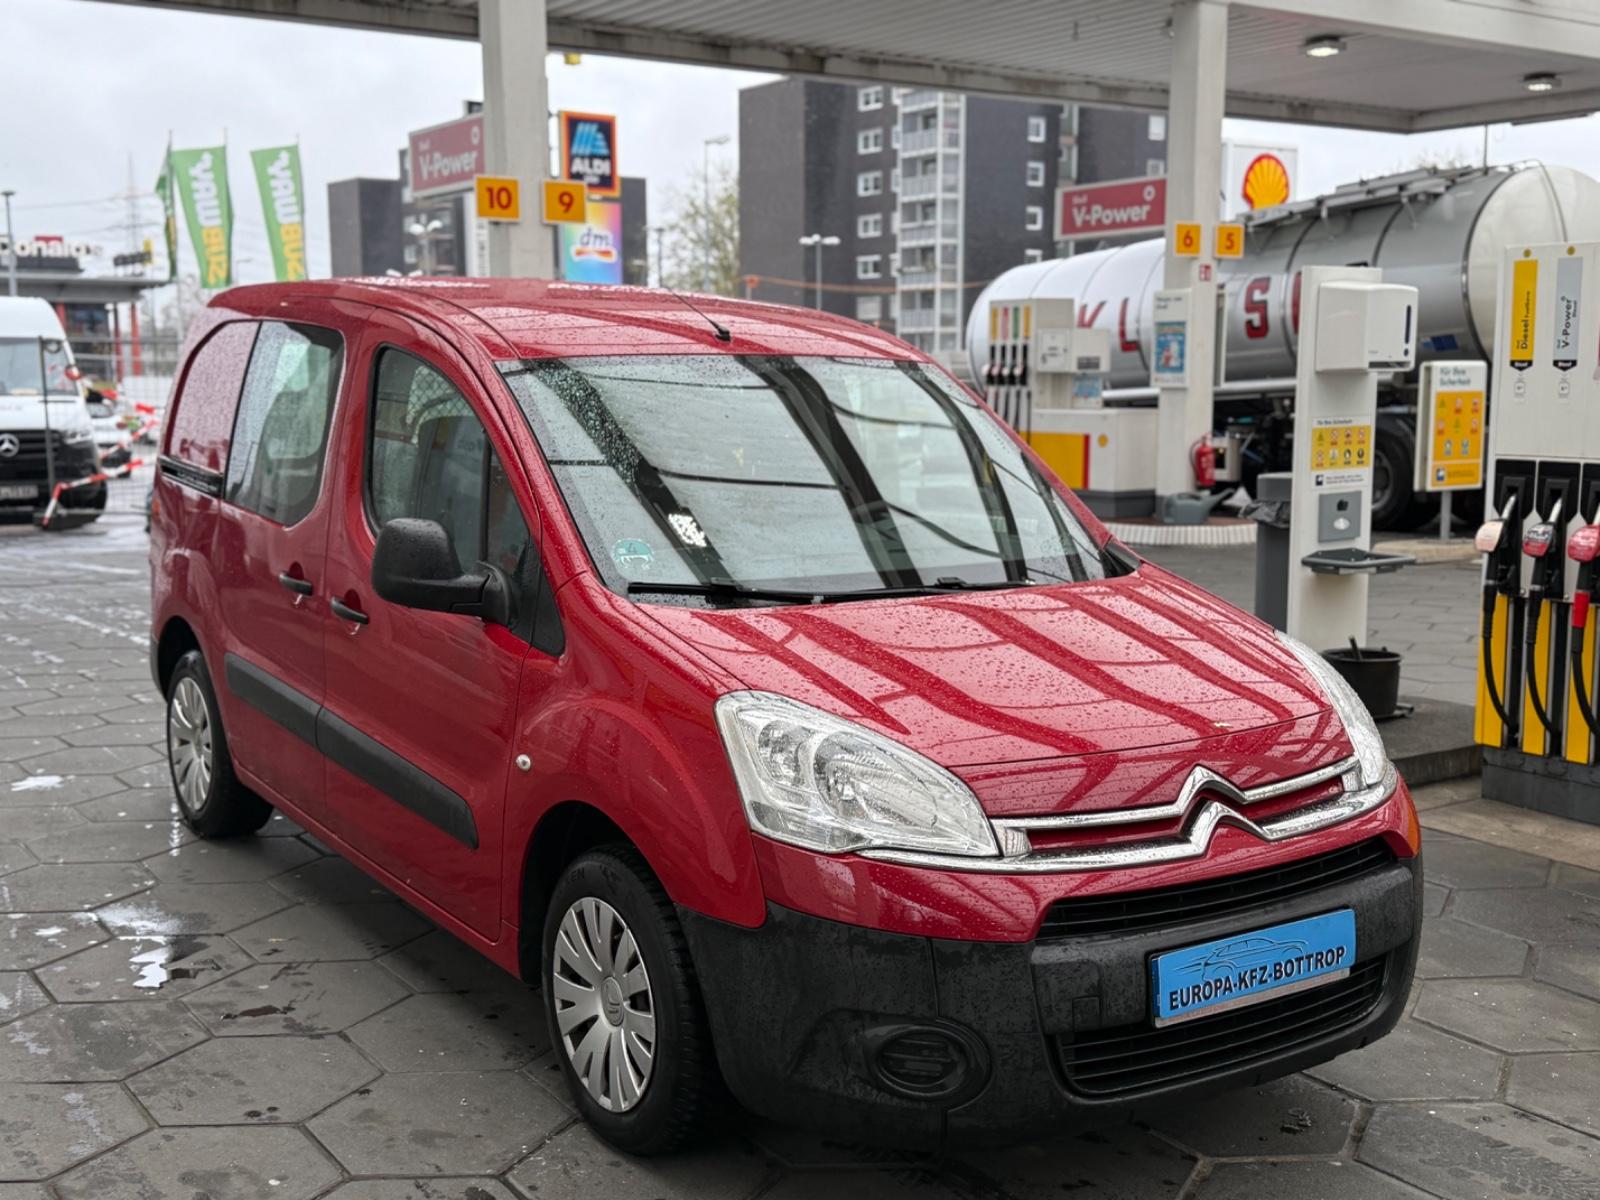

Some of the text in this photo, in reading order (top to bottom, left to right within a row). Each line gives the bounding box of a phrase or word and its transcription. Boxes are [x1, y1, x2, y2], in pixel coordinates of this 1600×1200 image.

[419, 152, 478, 181] V-Power
[571, 157, 611, 176] ALDI
[486, 187, 513, 210] 10
[558, 191, 574, 213] 9
[1072, 204, 1151, 228] V-Power
[579, 228, 611, 246] dm
[1183, 230, 1194, 247] 6
[1225, 233, 1235, 250] 5
[1561, 298, 1573, 348] V-Power
[1168, 945, 1347, 1011] EUROPA-KFZ-BOTTROP
